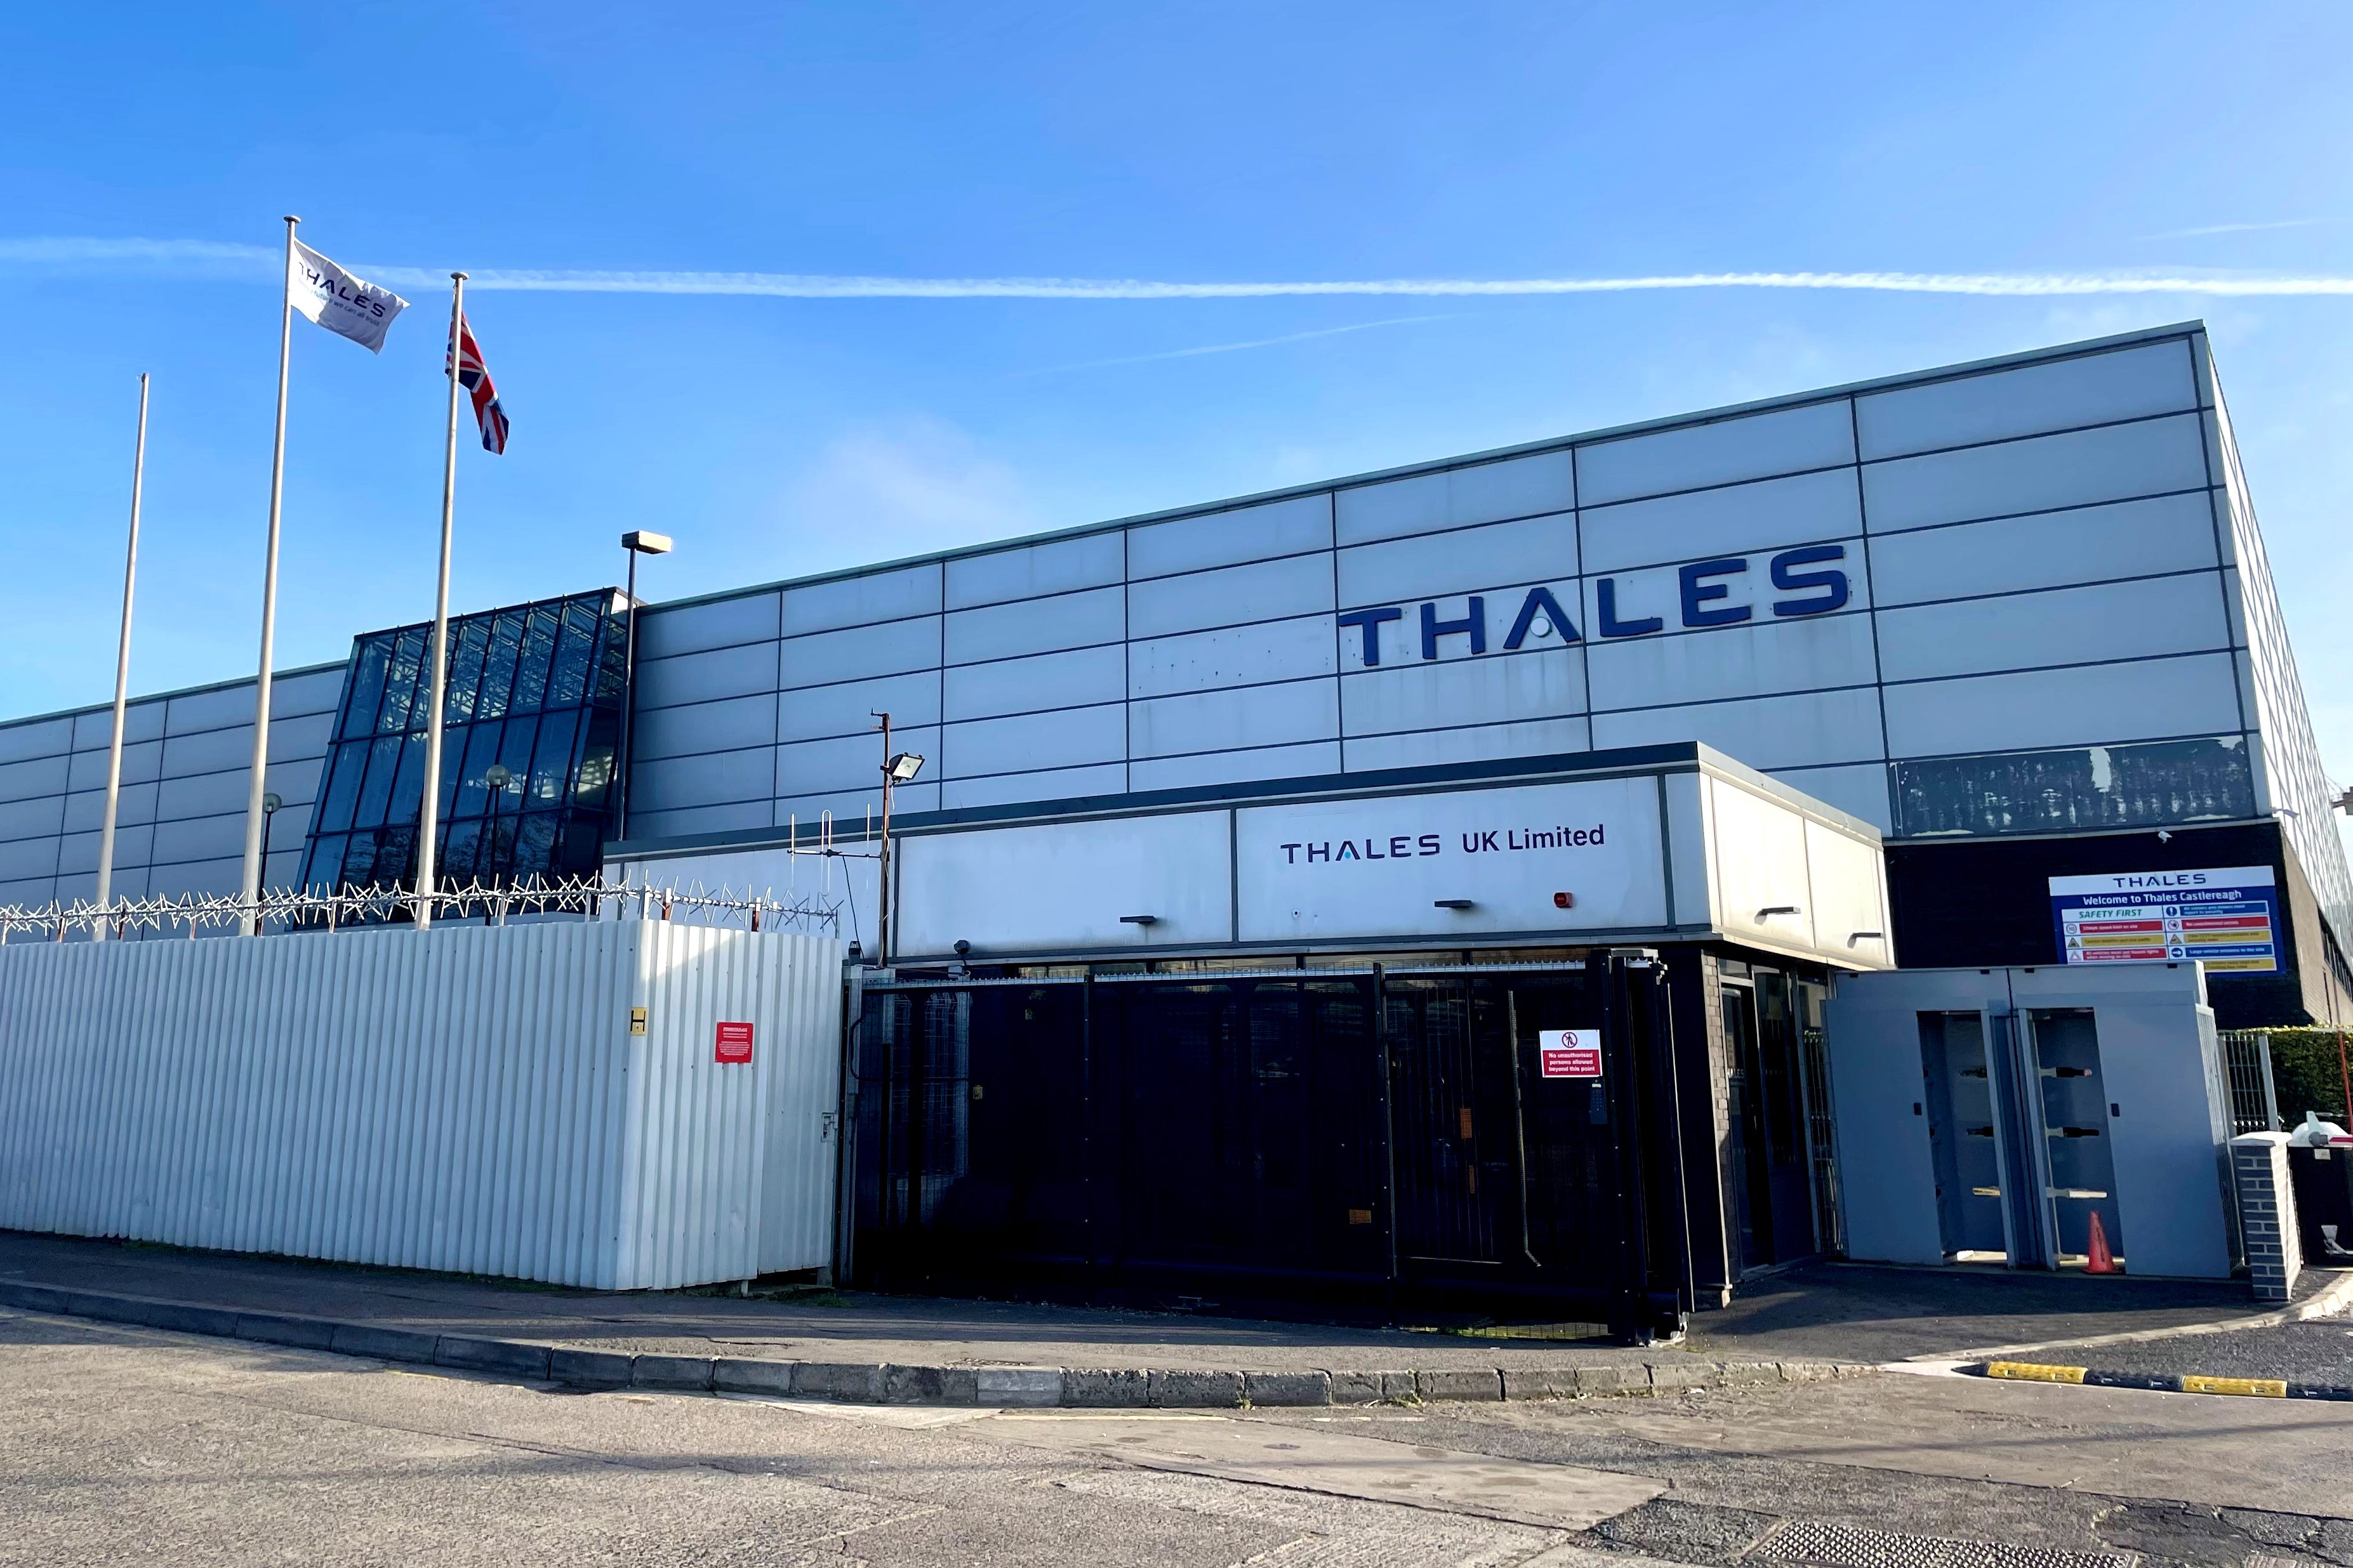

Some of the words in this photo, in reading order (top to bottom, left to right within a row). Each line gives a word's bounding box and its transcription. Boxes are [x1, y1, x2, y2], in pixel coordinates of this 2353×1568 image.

[298, 261, 386, 318] THALES
[1338, 544, 1849, 666] THALES
[1280, 834, 1440, 864] THALES
[1462, 830, 1500, 853] UK
[1508, 824, 1605, 850] Limited
[2112, 874, 2206, 888] THALES
[2083, 896, 2128, 906] Welcome
[2130, 895, 2142, 904] to
[2143, 893, 2178, 902] Thales
[2180, 890, 2242, 900] Castlereagh
[2079, 910, 2114, 919] SAFETY
[2116, 909, 2142, 917] FIRST
[630, 1010, 646, 1032] H
